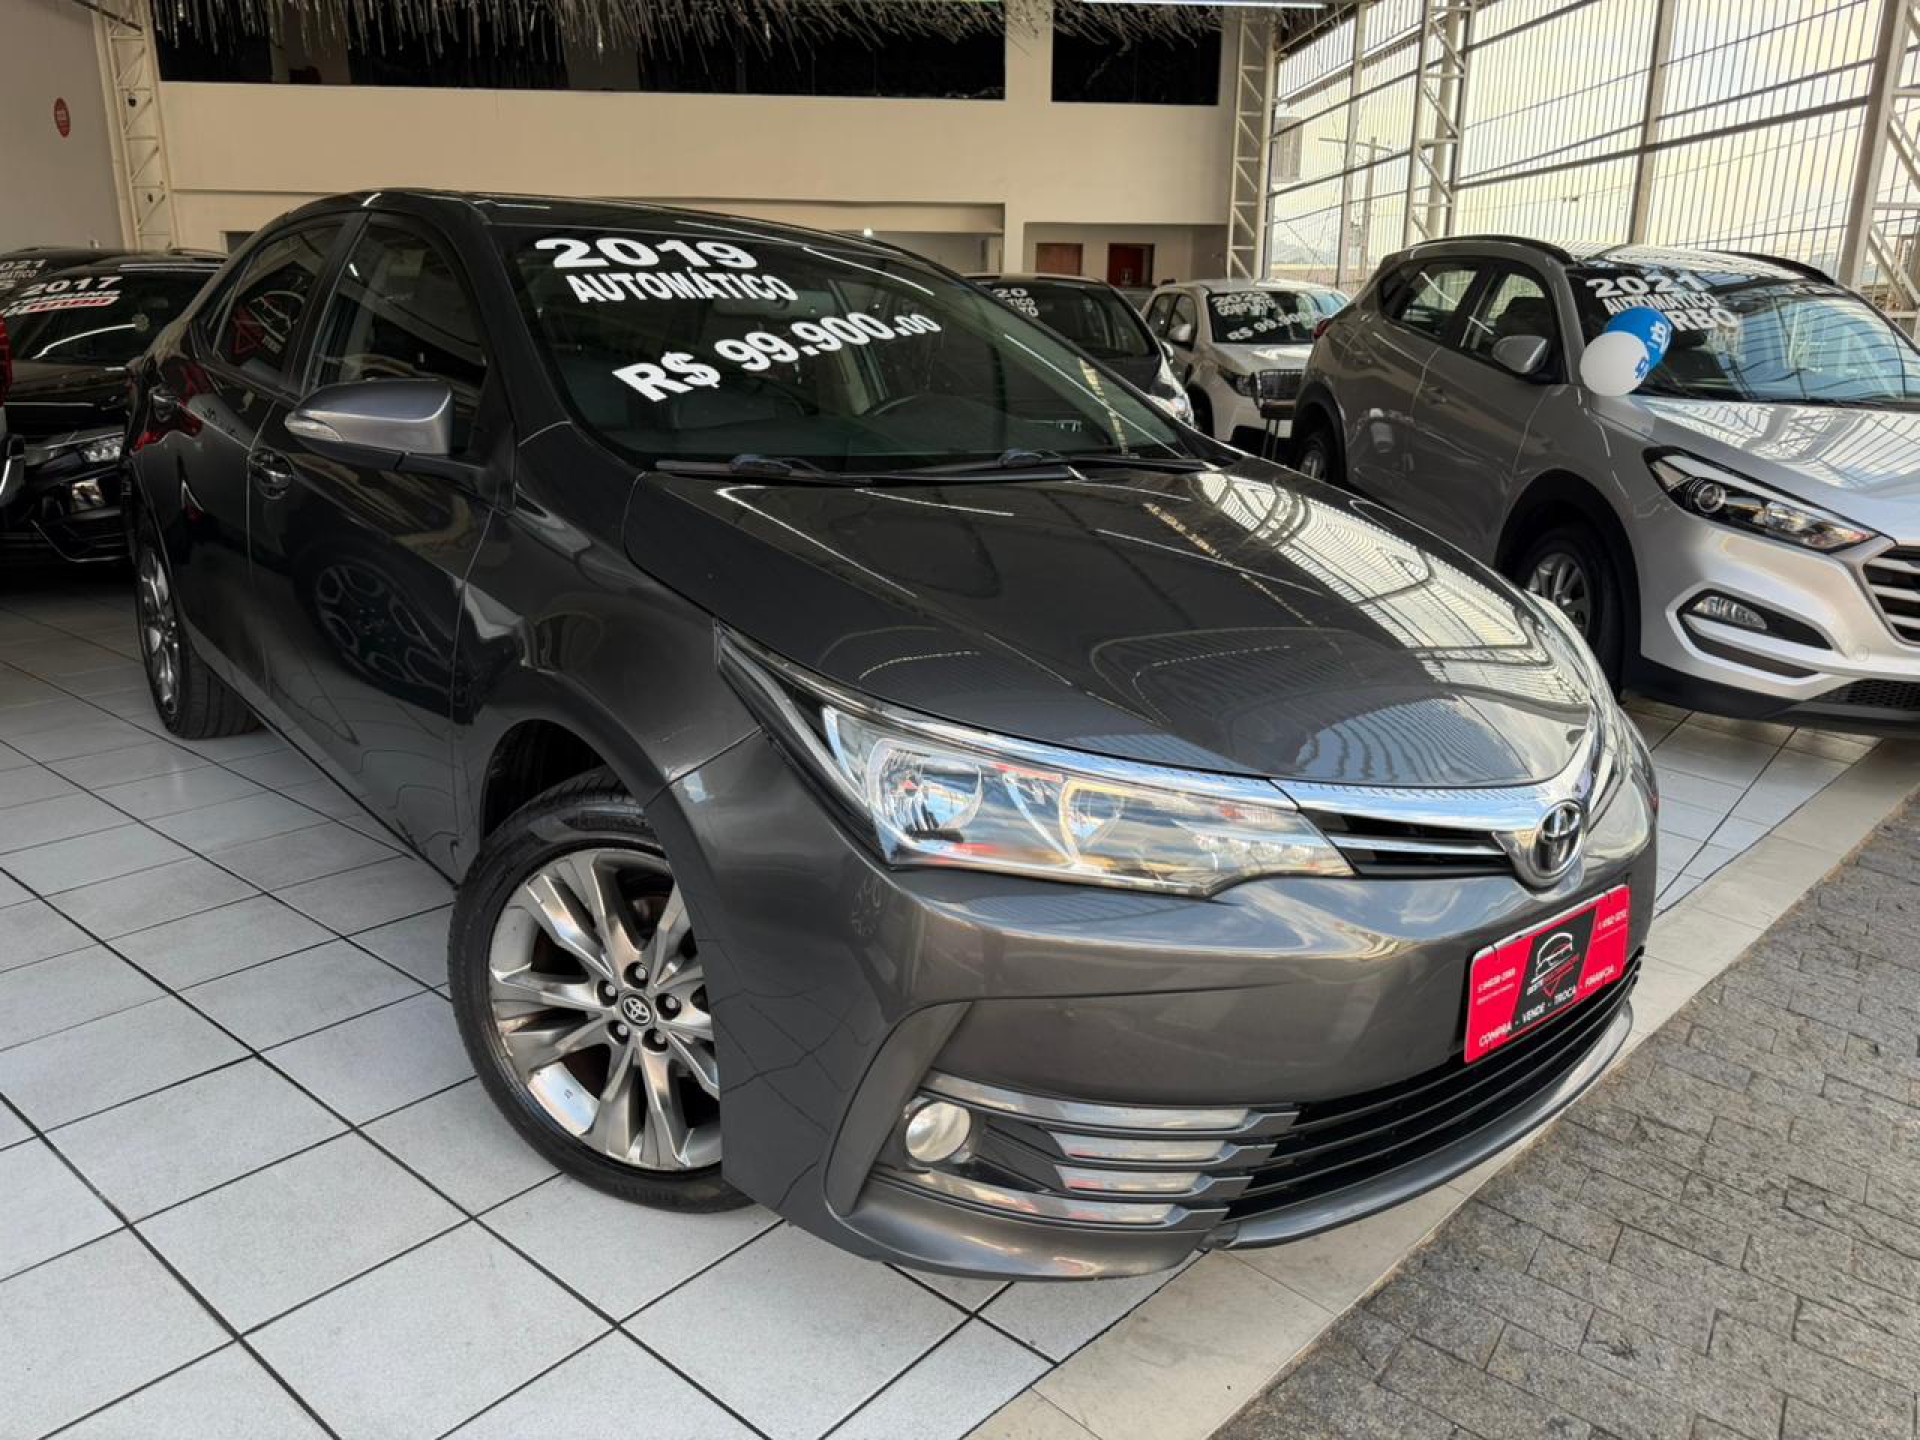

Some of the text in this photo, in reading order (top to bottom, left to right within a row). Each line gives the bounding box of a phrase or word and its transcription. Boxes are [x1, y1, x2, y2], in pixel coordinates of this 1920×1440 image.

[535, 238, 758, 269] 2019
[20, 276, 123, 297] 2017
[566, 267, 798, 303] AUTOMÁTICO
[1586, 275, 1707, 298] 2021
[1664, 308, 1739, 331] RBO
[612, 351, 721, 402] R$
[1478, 1020, 1512, 1048] COMPRA
